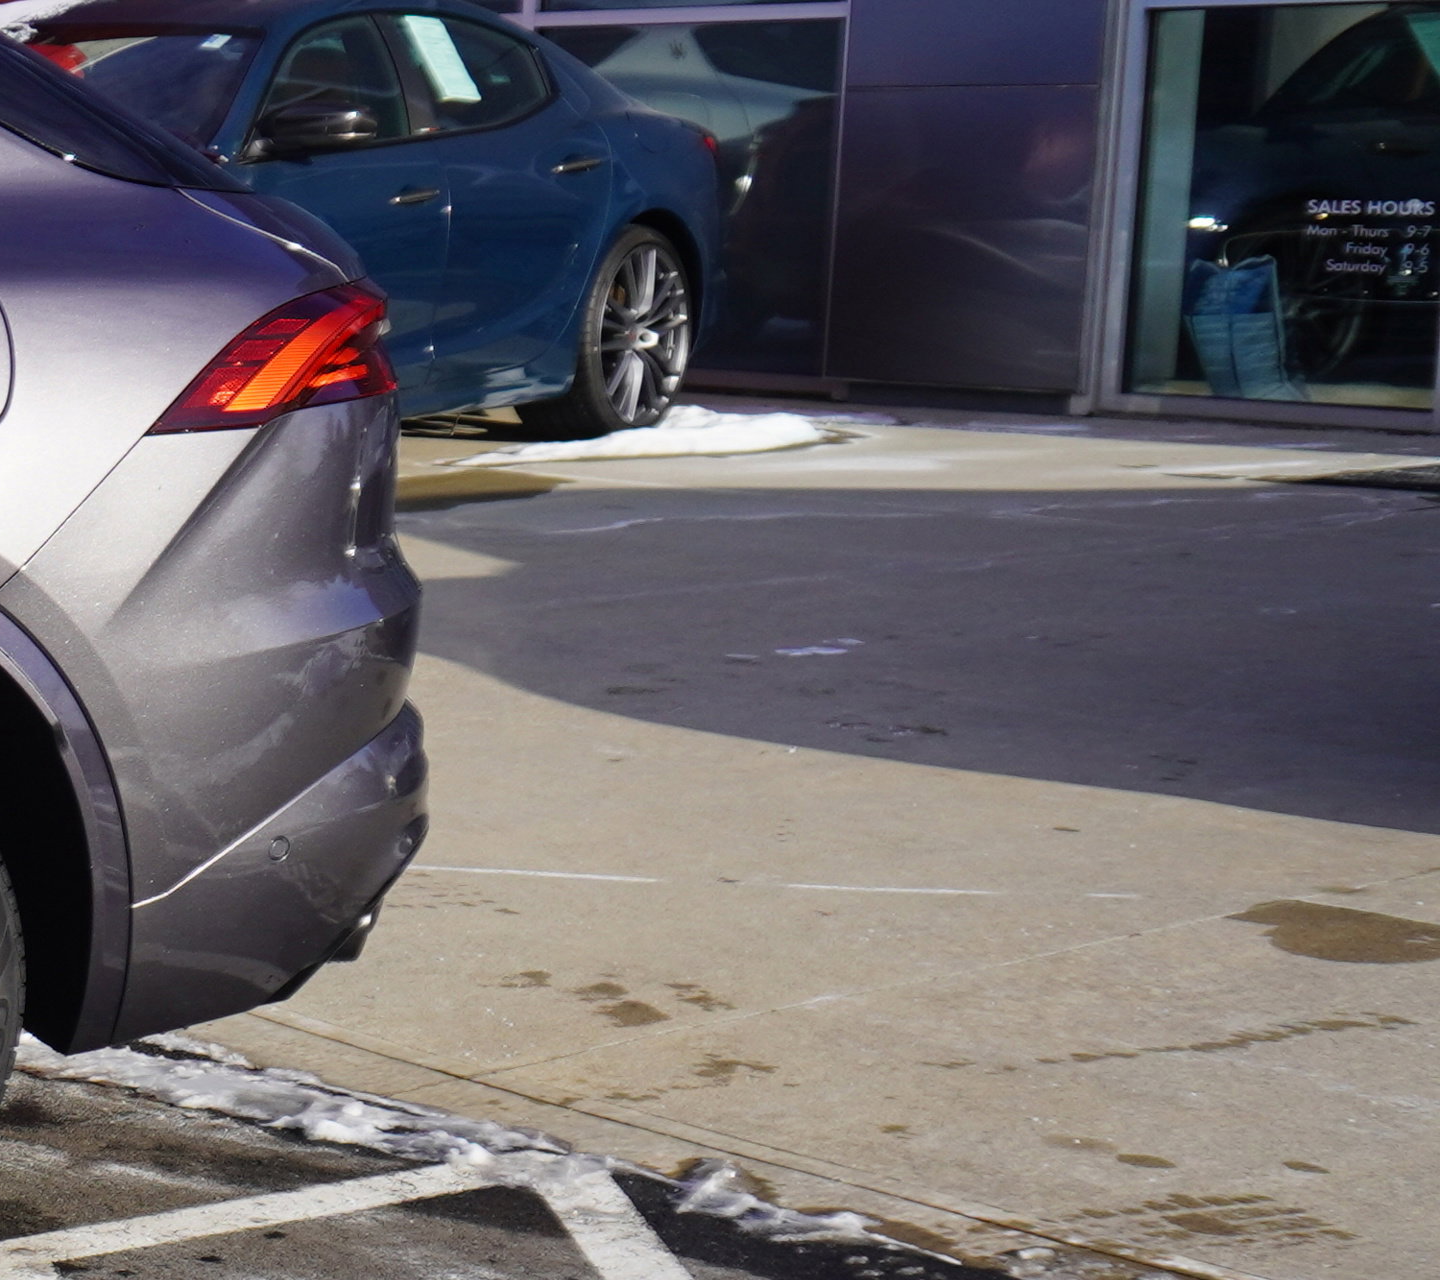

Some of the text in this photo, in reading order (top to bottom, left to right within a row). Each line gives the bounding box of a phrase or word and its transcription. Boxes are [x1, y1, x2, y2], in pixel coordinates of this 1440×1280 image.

[1308, 199, 1435, 216] SALES HOURS
[1307, 224, 1337, 236] Mon
[1352, 224, 1389, 237] Thurs
[1405, 225, 1433, 237] 9-7
[1345, 241, 1388, 258] Friday
[1326, 258, 1387, 275] Saturday
